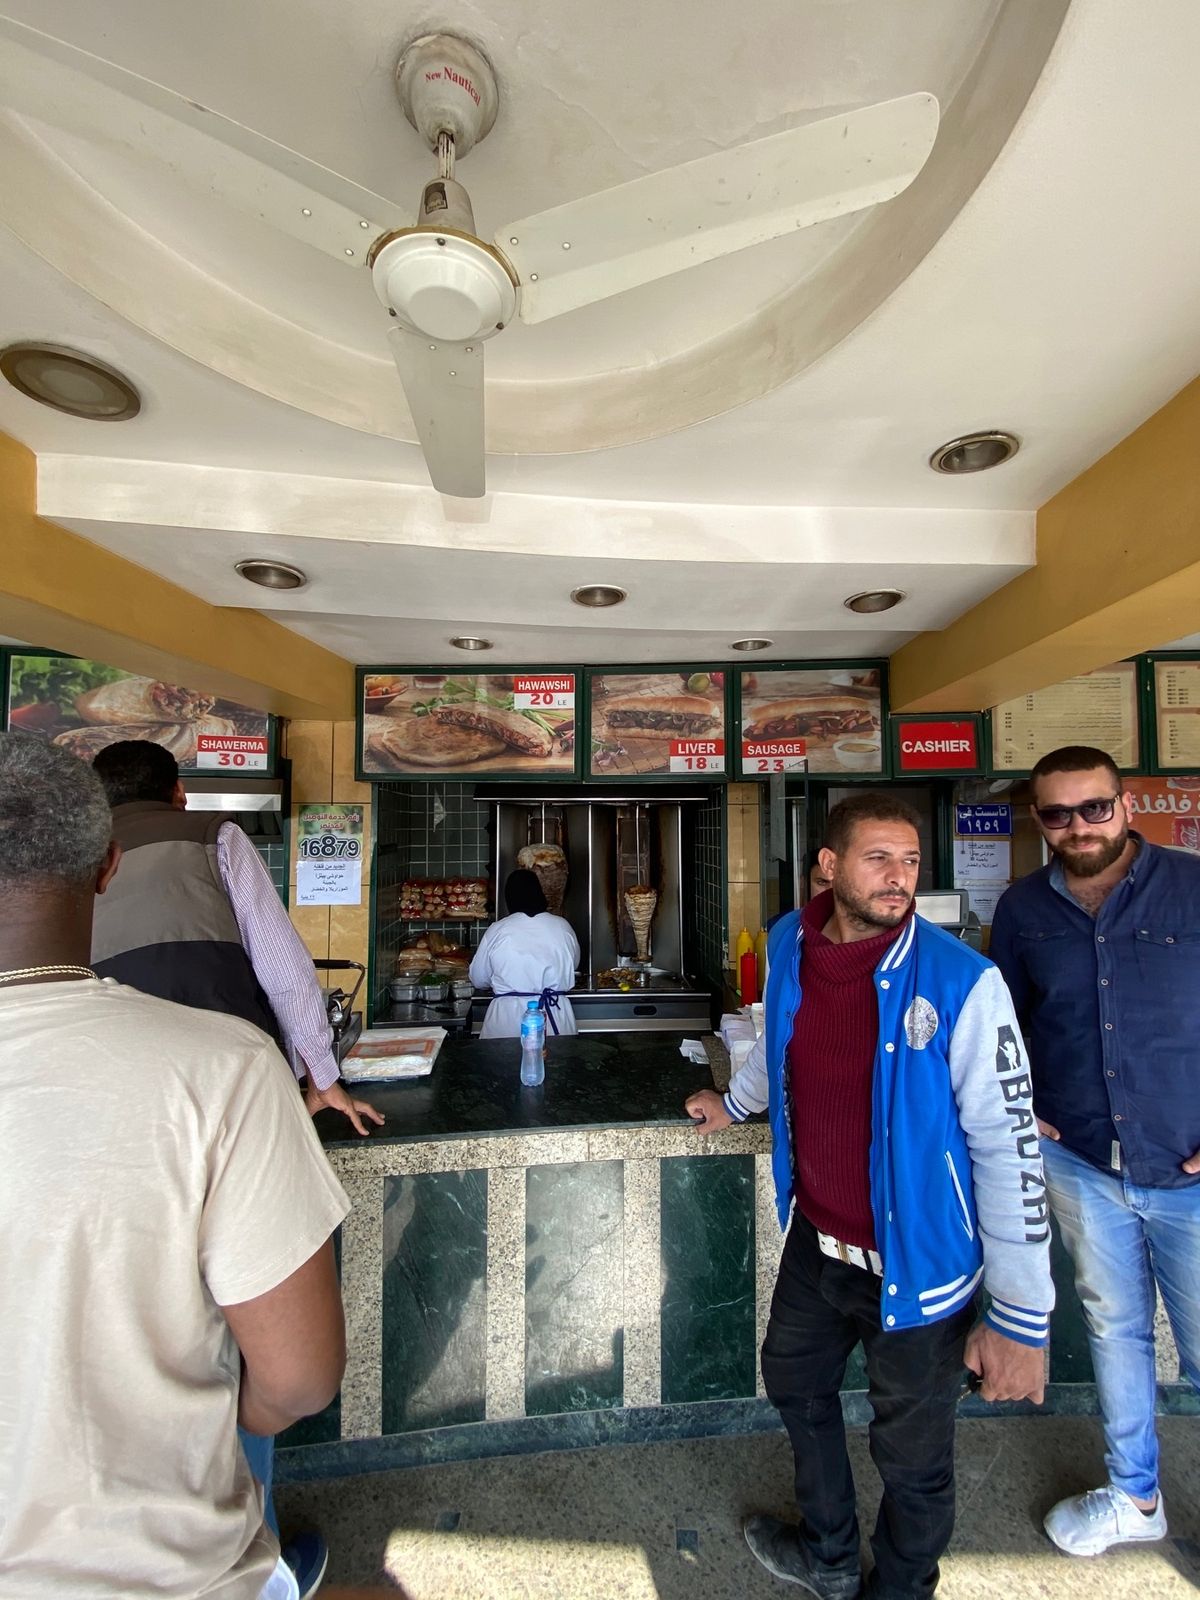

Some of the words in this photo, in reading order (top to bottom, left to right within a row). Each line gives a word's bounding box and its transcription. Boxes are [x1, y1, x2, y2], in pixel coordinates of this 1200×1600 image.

[425, 71, 441, 83] New
[444, 66, 482, 107] Nautical
[518, 680, 570, 691] HAWAWSHI
[530, 693, 554, 705] 20
[201, 739, 264, 751] SHAWERMA
[678, 742, 716, 754] LIVER
[747, 743, 801, 755] SAUSAGE
[901, 740, 971, 753] CASHIER
[217, 753, 246, 766] 30
[684, 757, 708, 770] 18
[757, 758, 785, 772] 23
[975, 805, 1008, 817] تأسست
[967, 819, 1000, 832] ١٩٥٩
[300, 834, 360, 858] 16879
